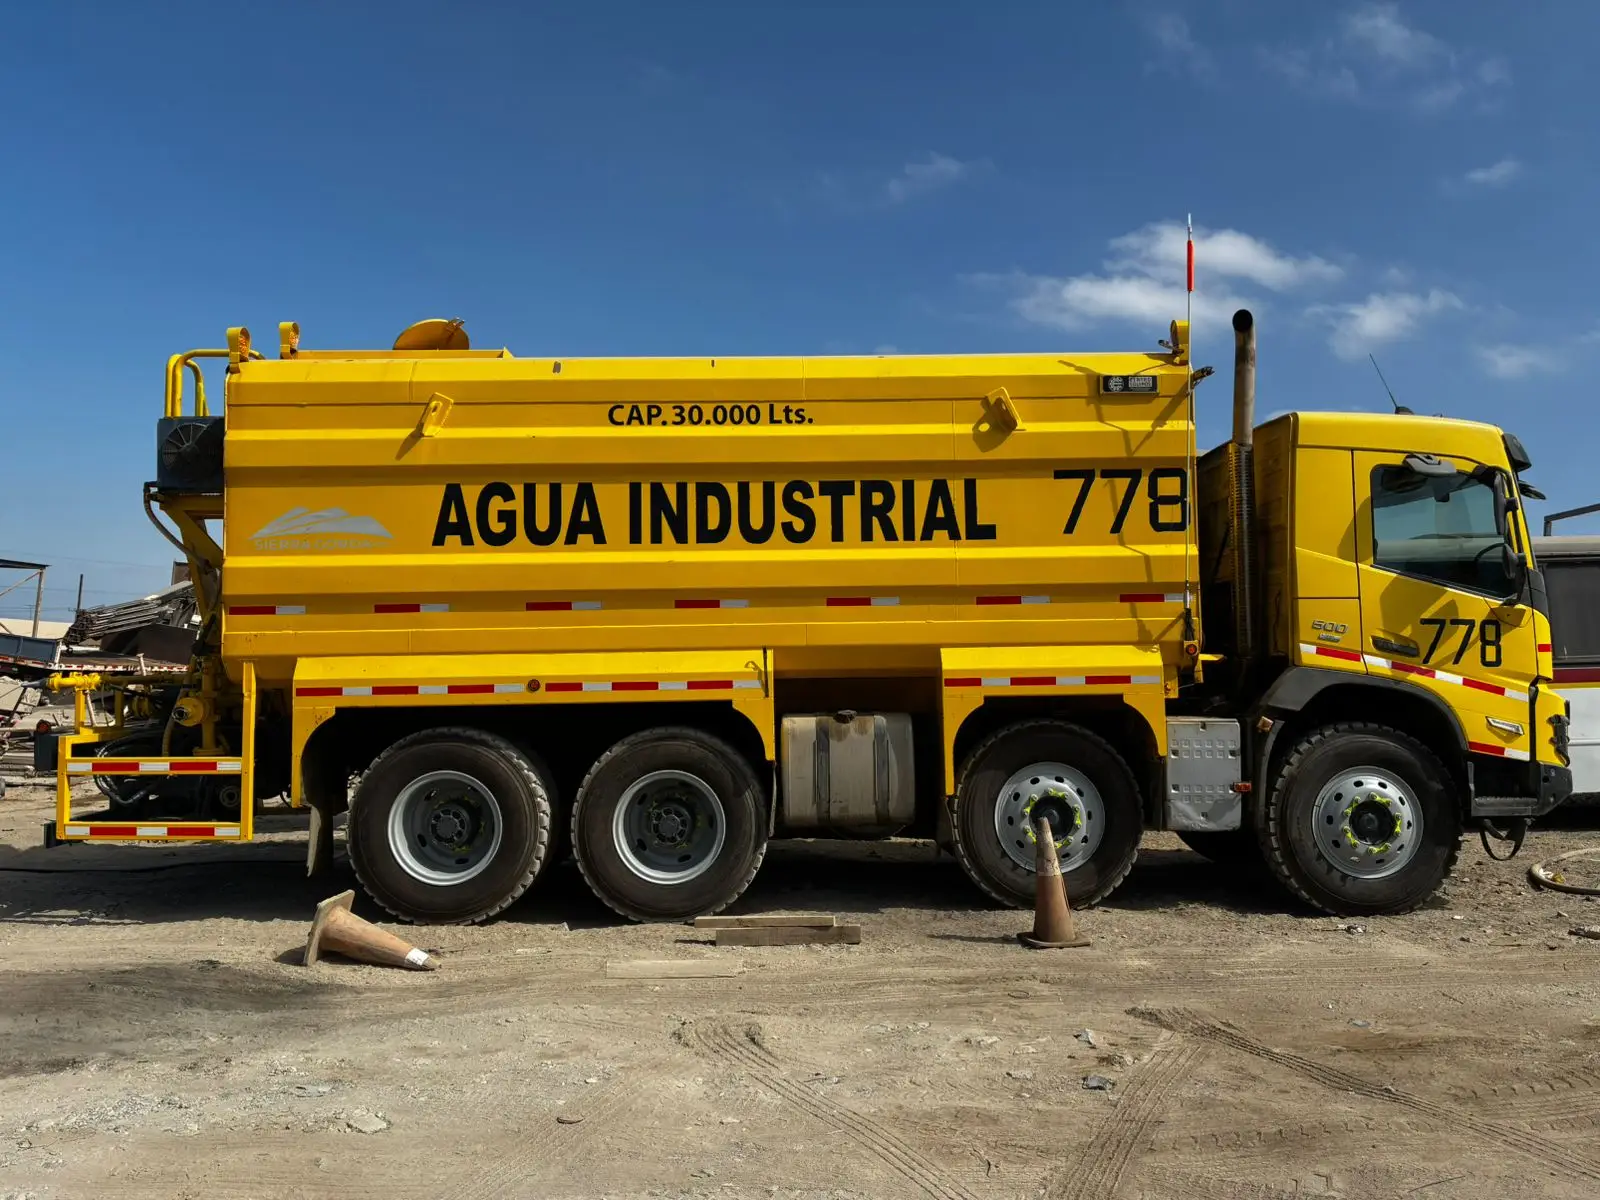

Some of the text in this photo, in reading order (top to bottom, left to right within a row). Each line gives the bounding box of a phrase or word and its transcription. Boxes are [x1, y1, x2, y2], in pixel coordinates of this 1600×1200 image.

[768, 403, 814, 425] Lts.
[431, 477, 997, 547] AGUA INDUSTRIAL
[1053, 467, 1191, 535] 778
[1311, 619, 1348, 635] 500
[1419, 617, 1503, 668] 778
